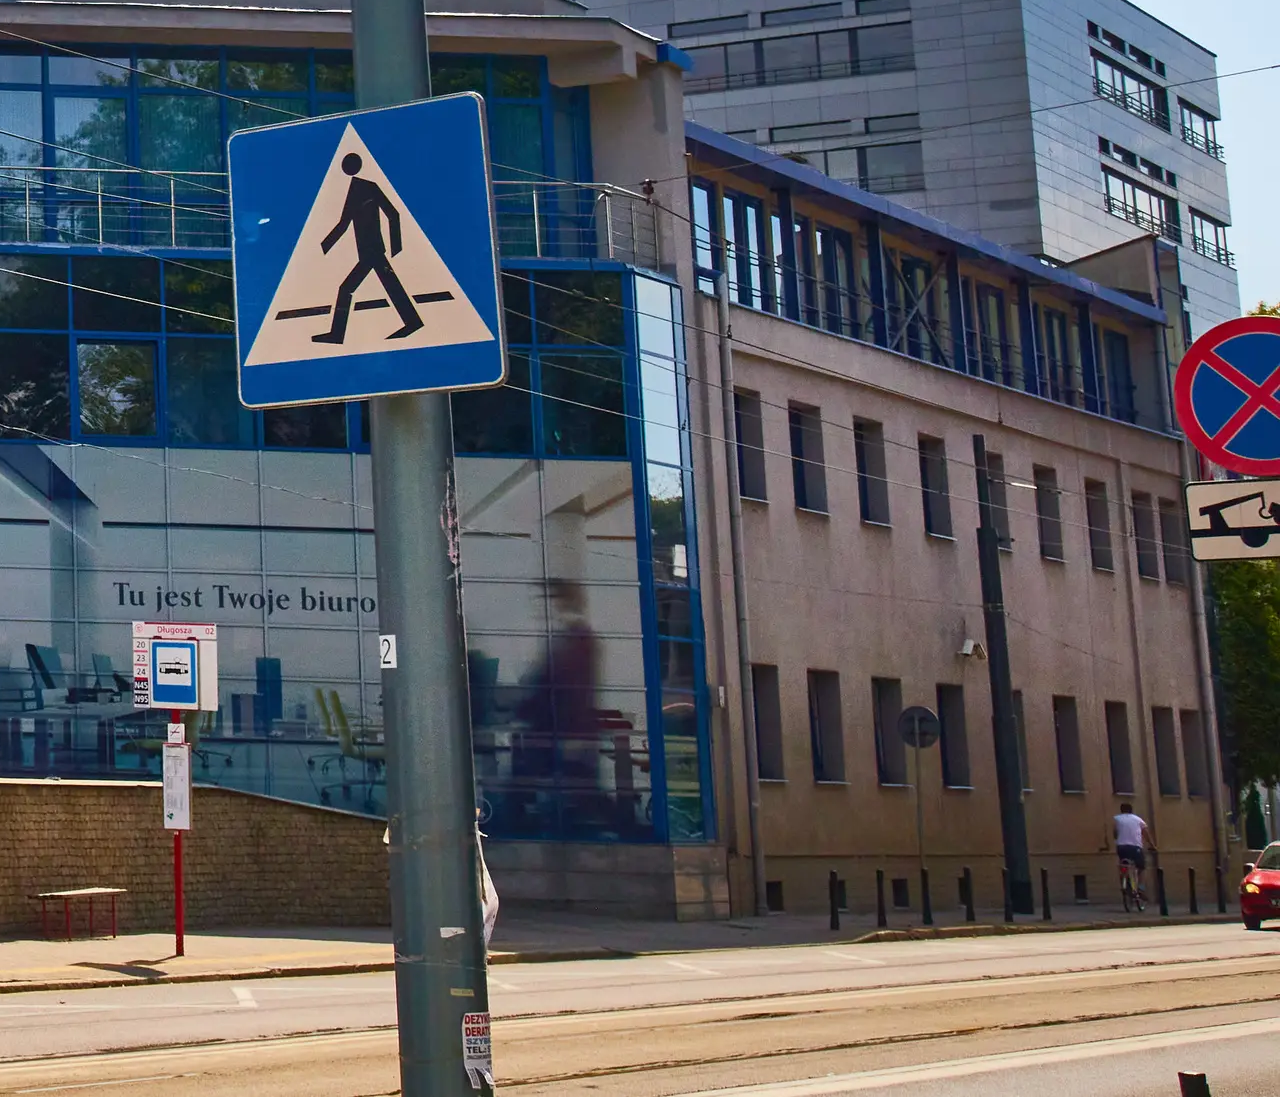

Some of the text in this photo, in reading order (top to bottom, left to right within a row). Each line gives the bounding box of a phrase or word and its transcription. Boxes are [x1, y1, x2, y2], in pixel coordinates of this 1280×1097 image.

[113, 582, 376, 615] Tu jest Twoje biuro
[157, 625, 214, 636] Długosza 02
[136, 641, 146, 649] 20
[134, 681, 148, 689] N45
[134, 695, 148, 703] N95
